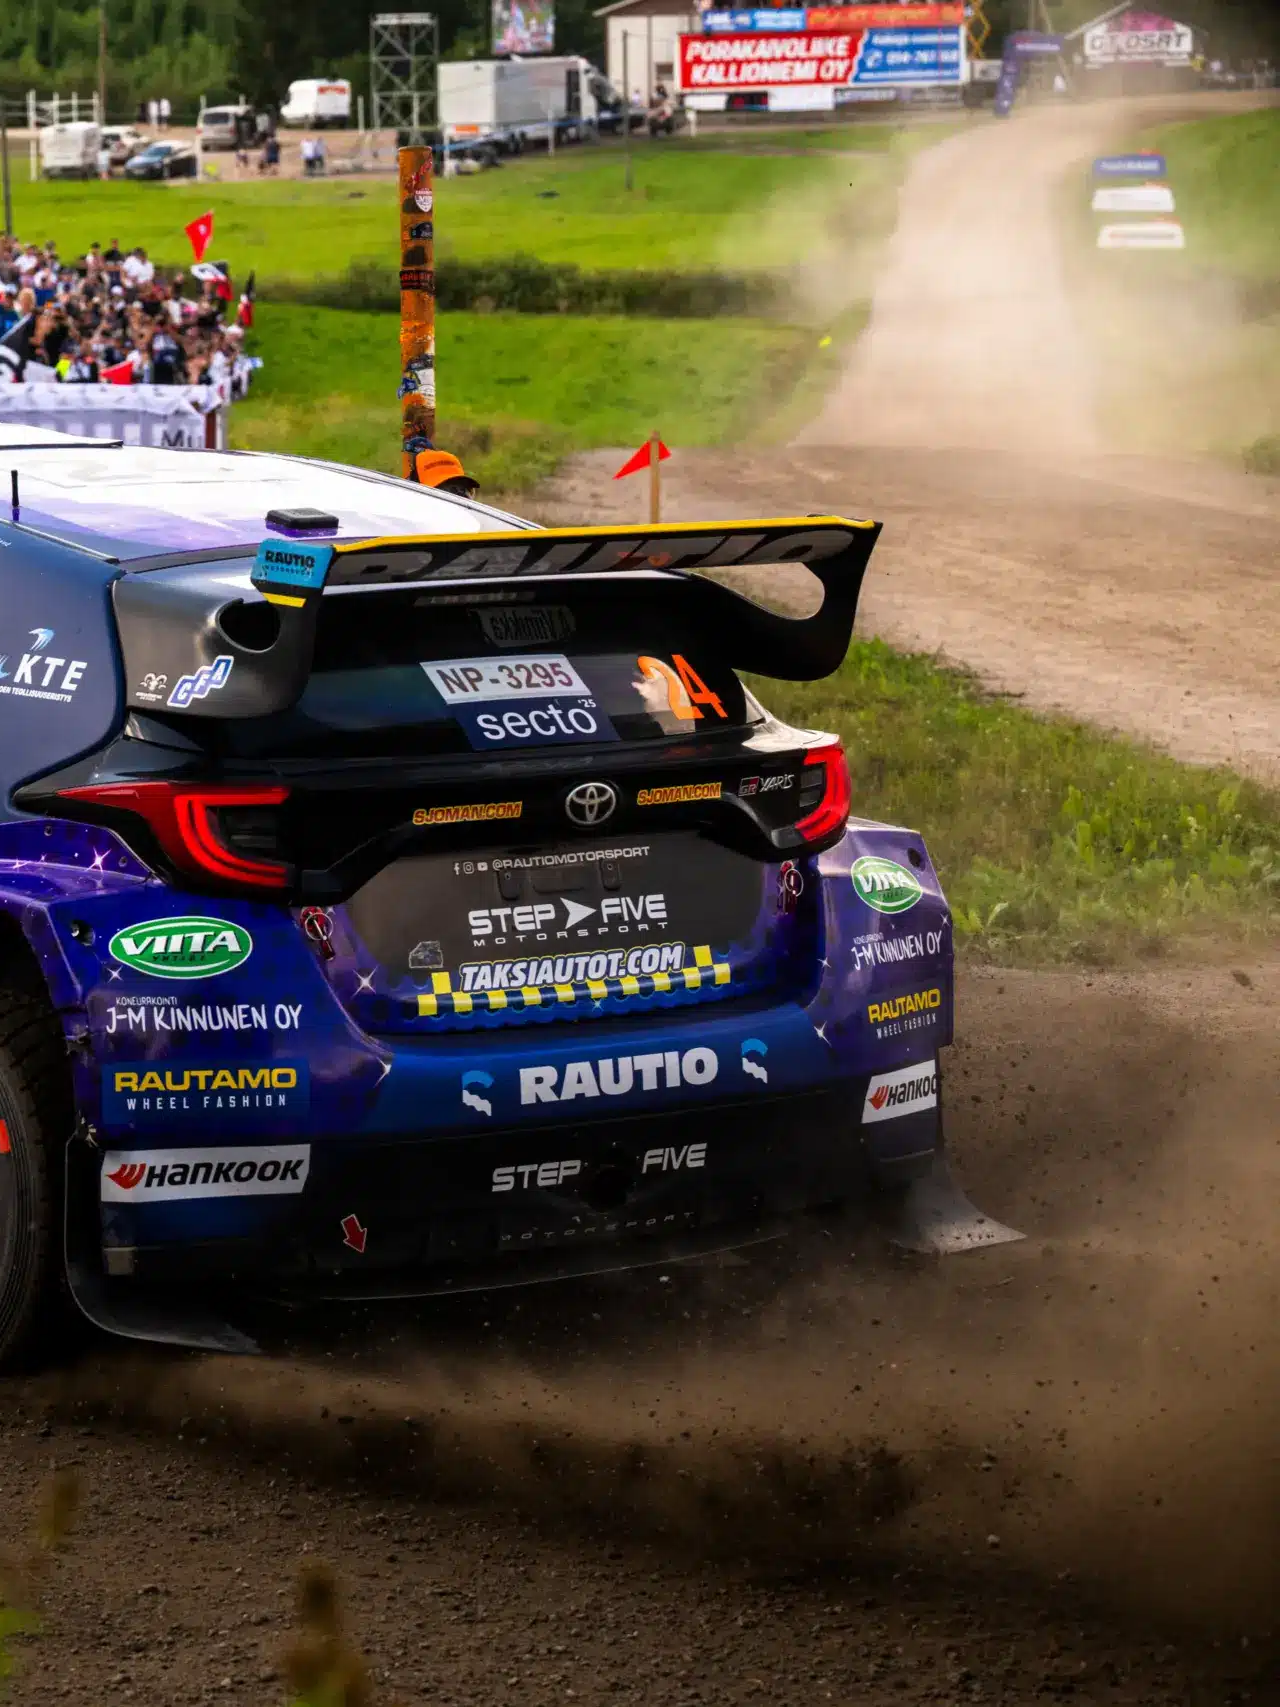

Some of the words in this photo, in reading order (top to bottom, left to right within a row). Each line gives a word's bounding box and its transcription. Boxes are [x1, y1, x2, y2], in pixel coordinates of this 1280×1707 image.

[265, 550, 316, 568] RAUTIO
[13, 653, 87, 691] KTE
[637, 653, 729, 721] 24
[476, 702, 598, 741] secto
[492, 846, 650, 871] @RAUTIOMOTORSPORT
[469, 903, 556, 936] STEP
[600, 893, 669, 924] FIVE
[119, 930, 242, 956] VIITA
[473, 921, 669, 948] MOTORSPORT
[851, 943, 875, 971] J-M
[874, 933, 924, 964] KINNUNEN
[926, 930, 942, 955] OY
[460, 943, 684, 993] TAKSIAUTOT.COM
[116, 996, 178, 1006] KONEURAKOINTI
[868, 988, 941, 1025] RAUTAMO
[106, 1005, 146, 1034] J-M
[154, 1003, 269, 1032] KINNUNEN
[274, 1003, 303, 1030] OY
[877, 1020, 902, 1040] WHEEL
[903, 1012, 937, 1033] FASHION
[114, 1067, 297, 1093] RAUTAMO
[519, 1047, 720, 1106] RAUTIO
[126, 1097, 190, 1111] WHEEL
[203, 1094, 286, 1109] FASHION
[491, 1159, 582, 1193] STEP
[641, 1142, 708, 1174] FIVE
